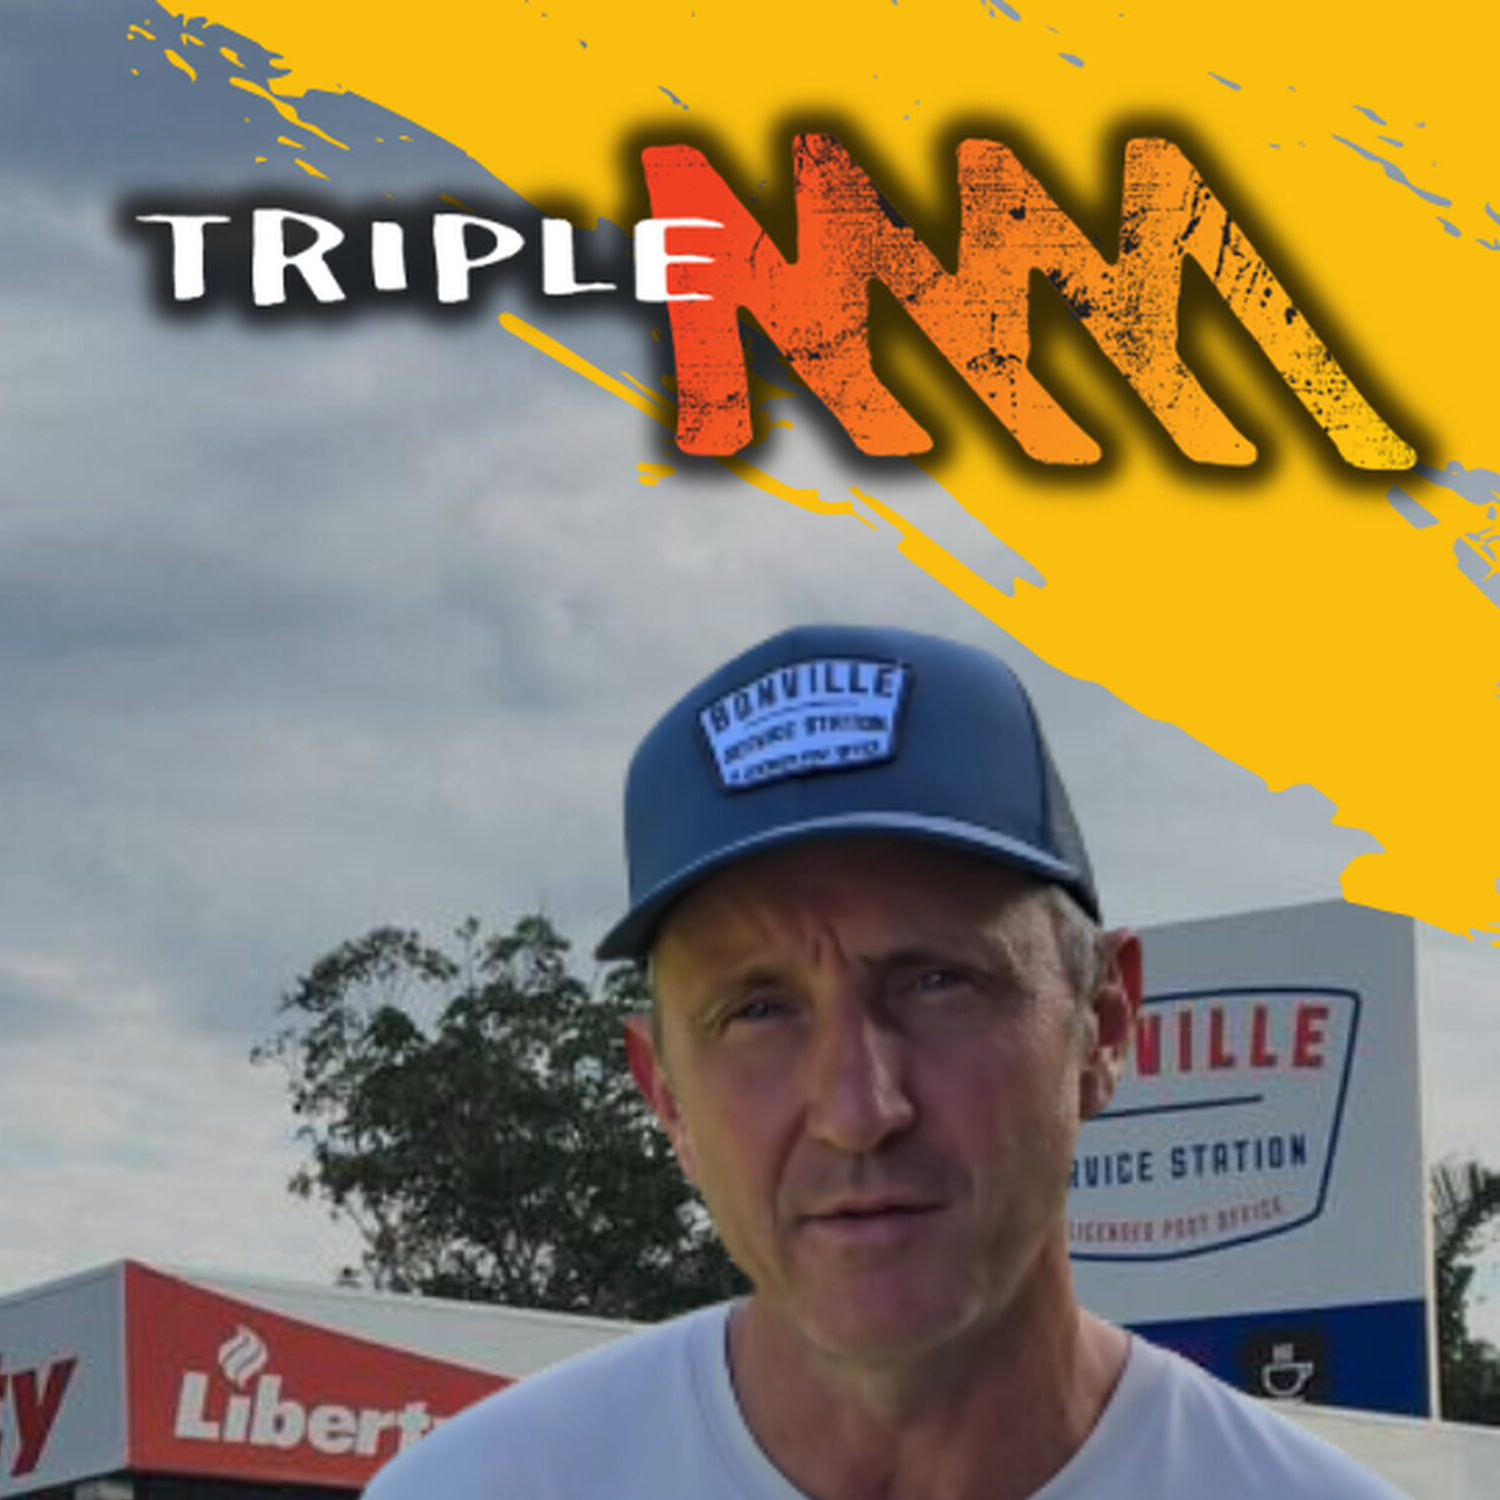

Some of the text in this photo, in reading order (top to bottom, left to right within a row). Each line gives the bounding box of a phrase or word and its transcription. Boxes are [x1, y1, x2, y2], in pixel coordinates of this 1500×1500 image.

[709, 663, 895, 735] BONVILLE
[1135, 1001, 1330, 1078] VILLE
[1171, 1134, 1306, 1180] STATION
[175, 1323, 452, 1457] Libert
